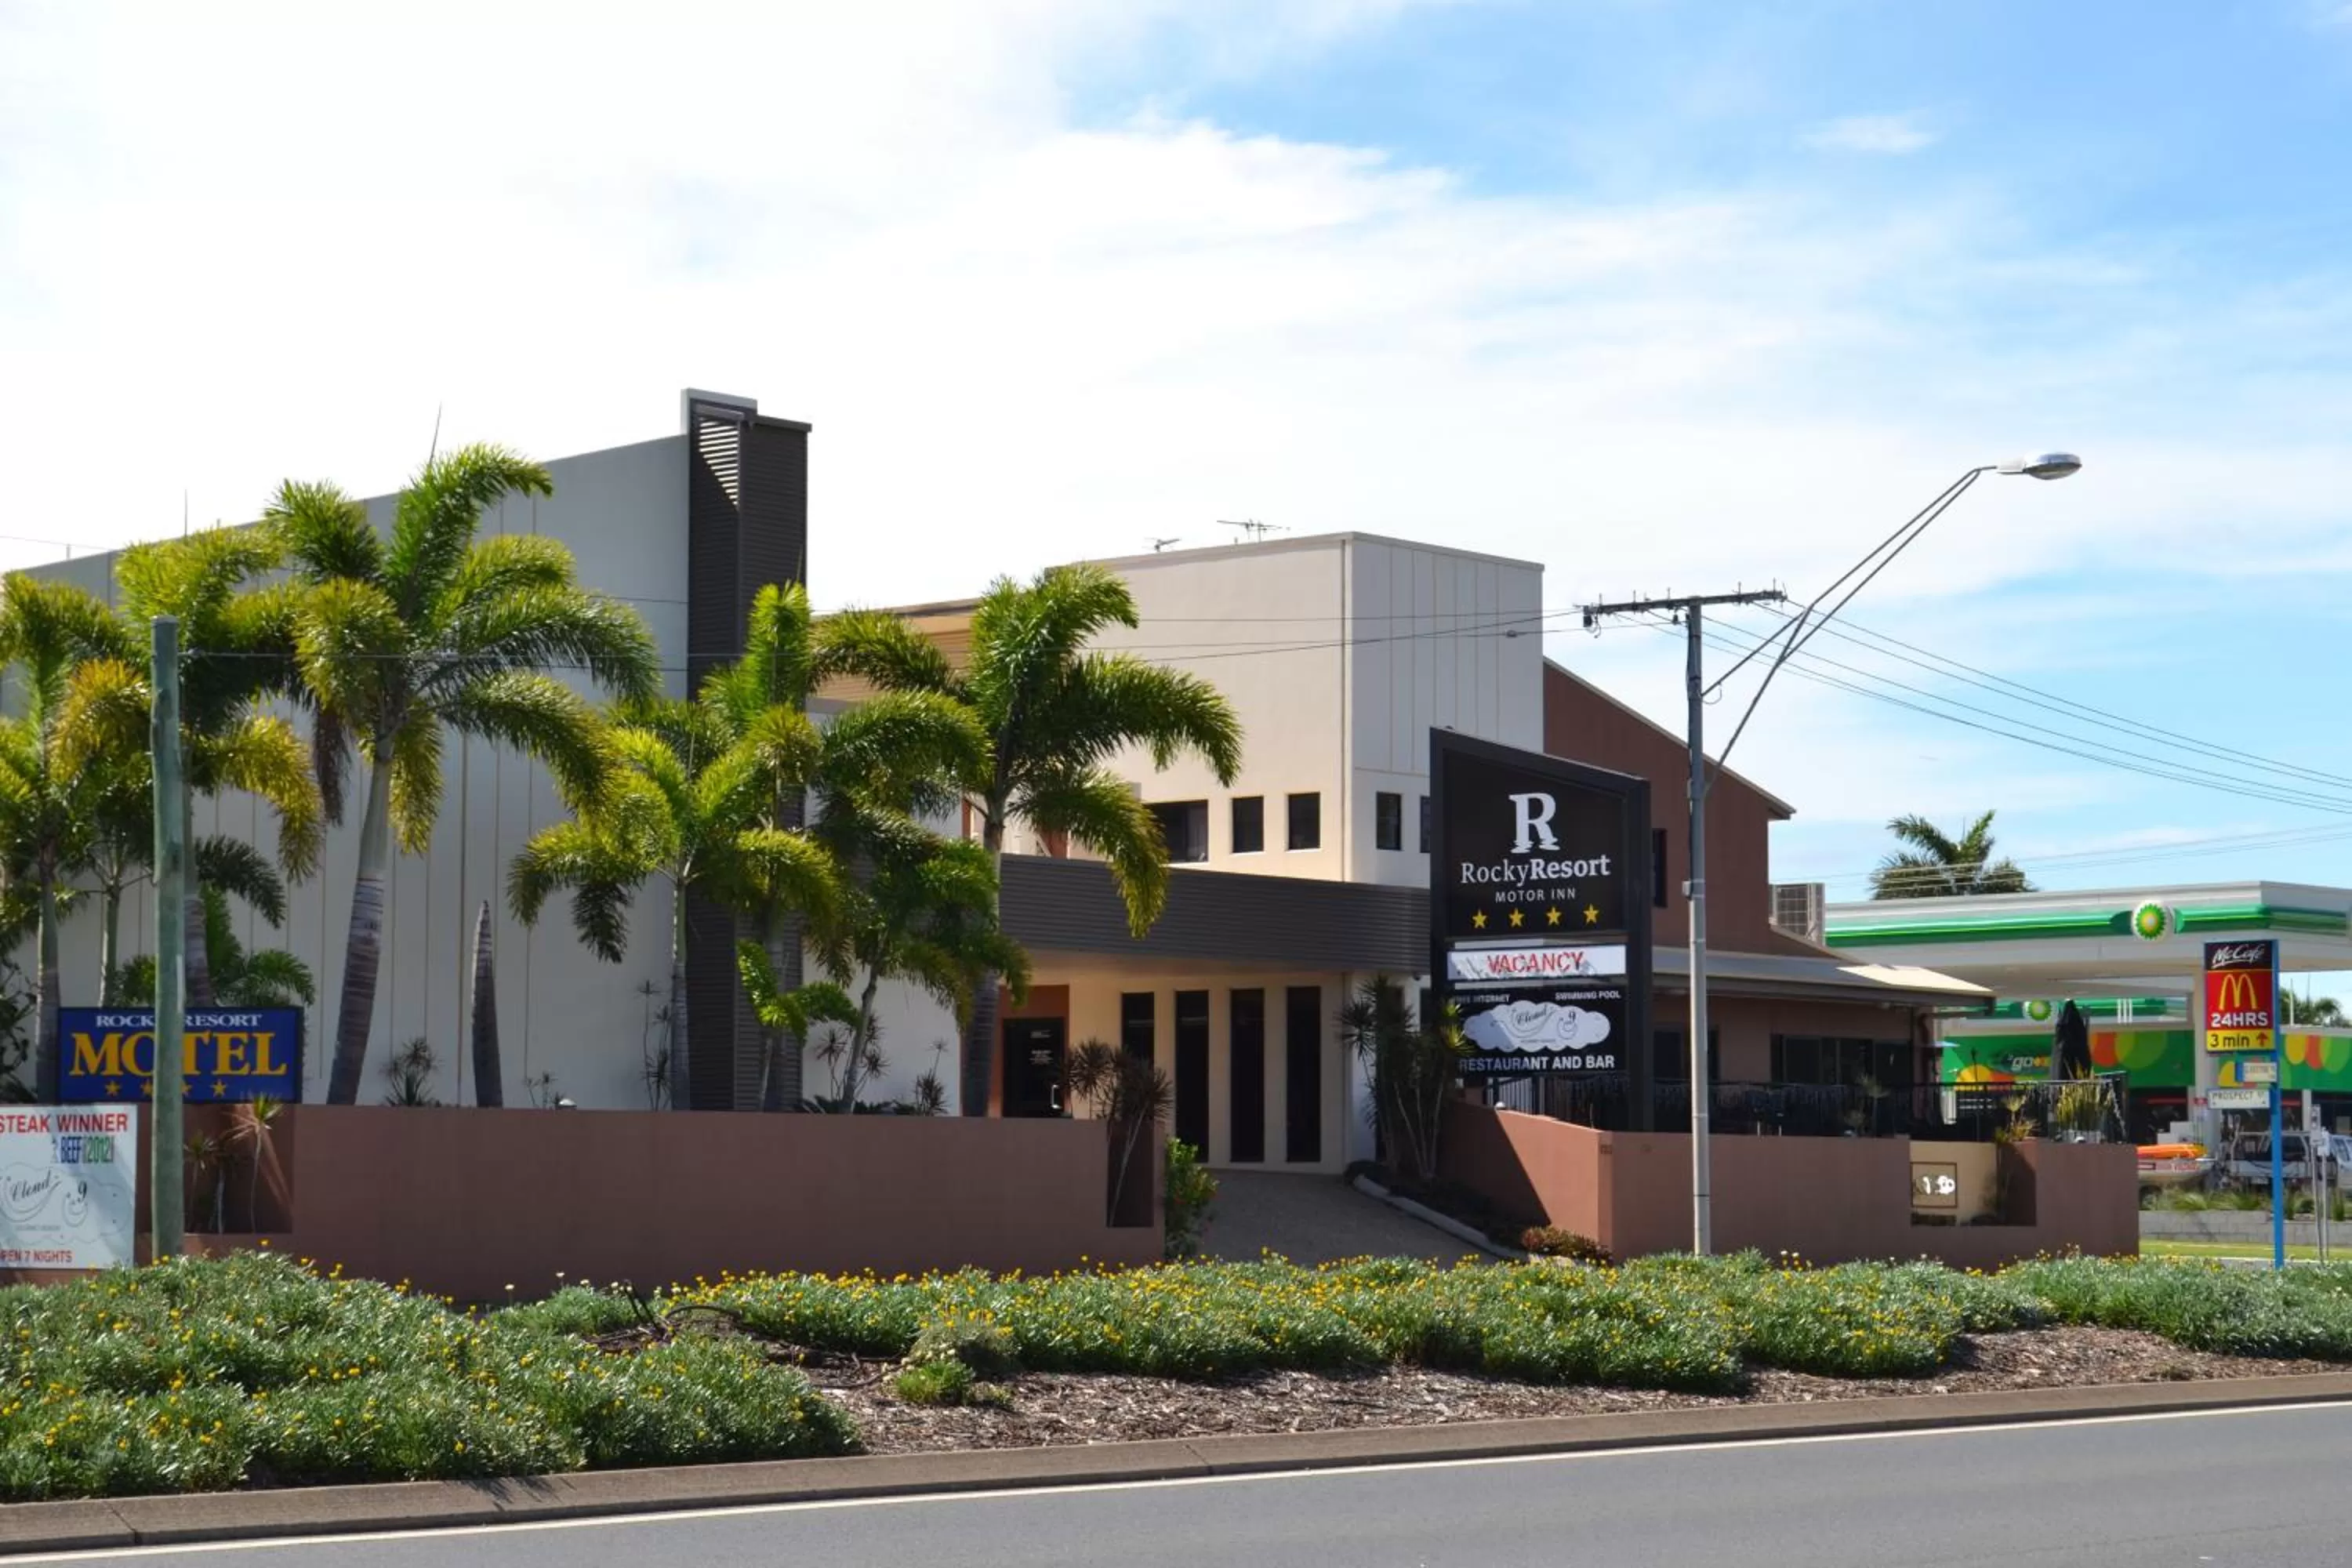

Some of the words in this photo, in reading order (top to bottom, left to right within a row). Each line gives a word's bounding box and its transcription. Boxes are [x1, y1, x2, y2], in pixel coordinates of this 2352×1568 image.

[1461, 855, 1611, 887] RockyResort
[1495, 888, 1544, 903] MOTOR
[1551, 887, 1576, 899] INN
[1486, 951, 1584, 974] VACANCY
[1555, 992, 1597, 1000] SWIMMING
[1599, 990, 1621, 999] POOL
[96, 1015, 154, 1027] ROCK
[2211, 1012, 2268, 1028] 24HRS
[2211, 1034, 2218, 1047] 3
[2223, 1034, 2250, 1047] min
[1459, 1056, 1548, 1071] RESTAURANT
[1552, 1055, 1582, 1069] AND
[1585, 1055, 1615, 1069] BAR
[0, 1114, 49, 1133] STEAK
[56, 1113, 128, 1131] WINNER
[24, 1250, 31, 1261] 7
[34, 1250, 73, 1263] NIGHTS
